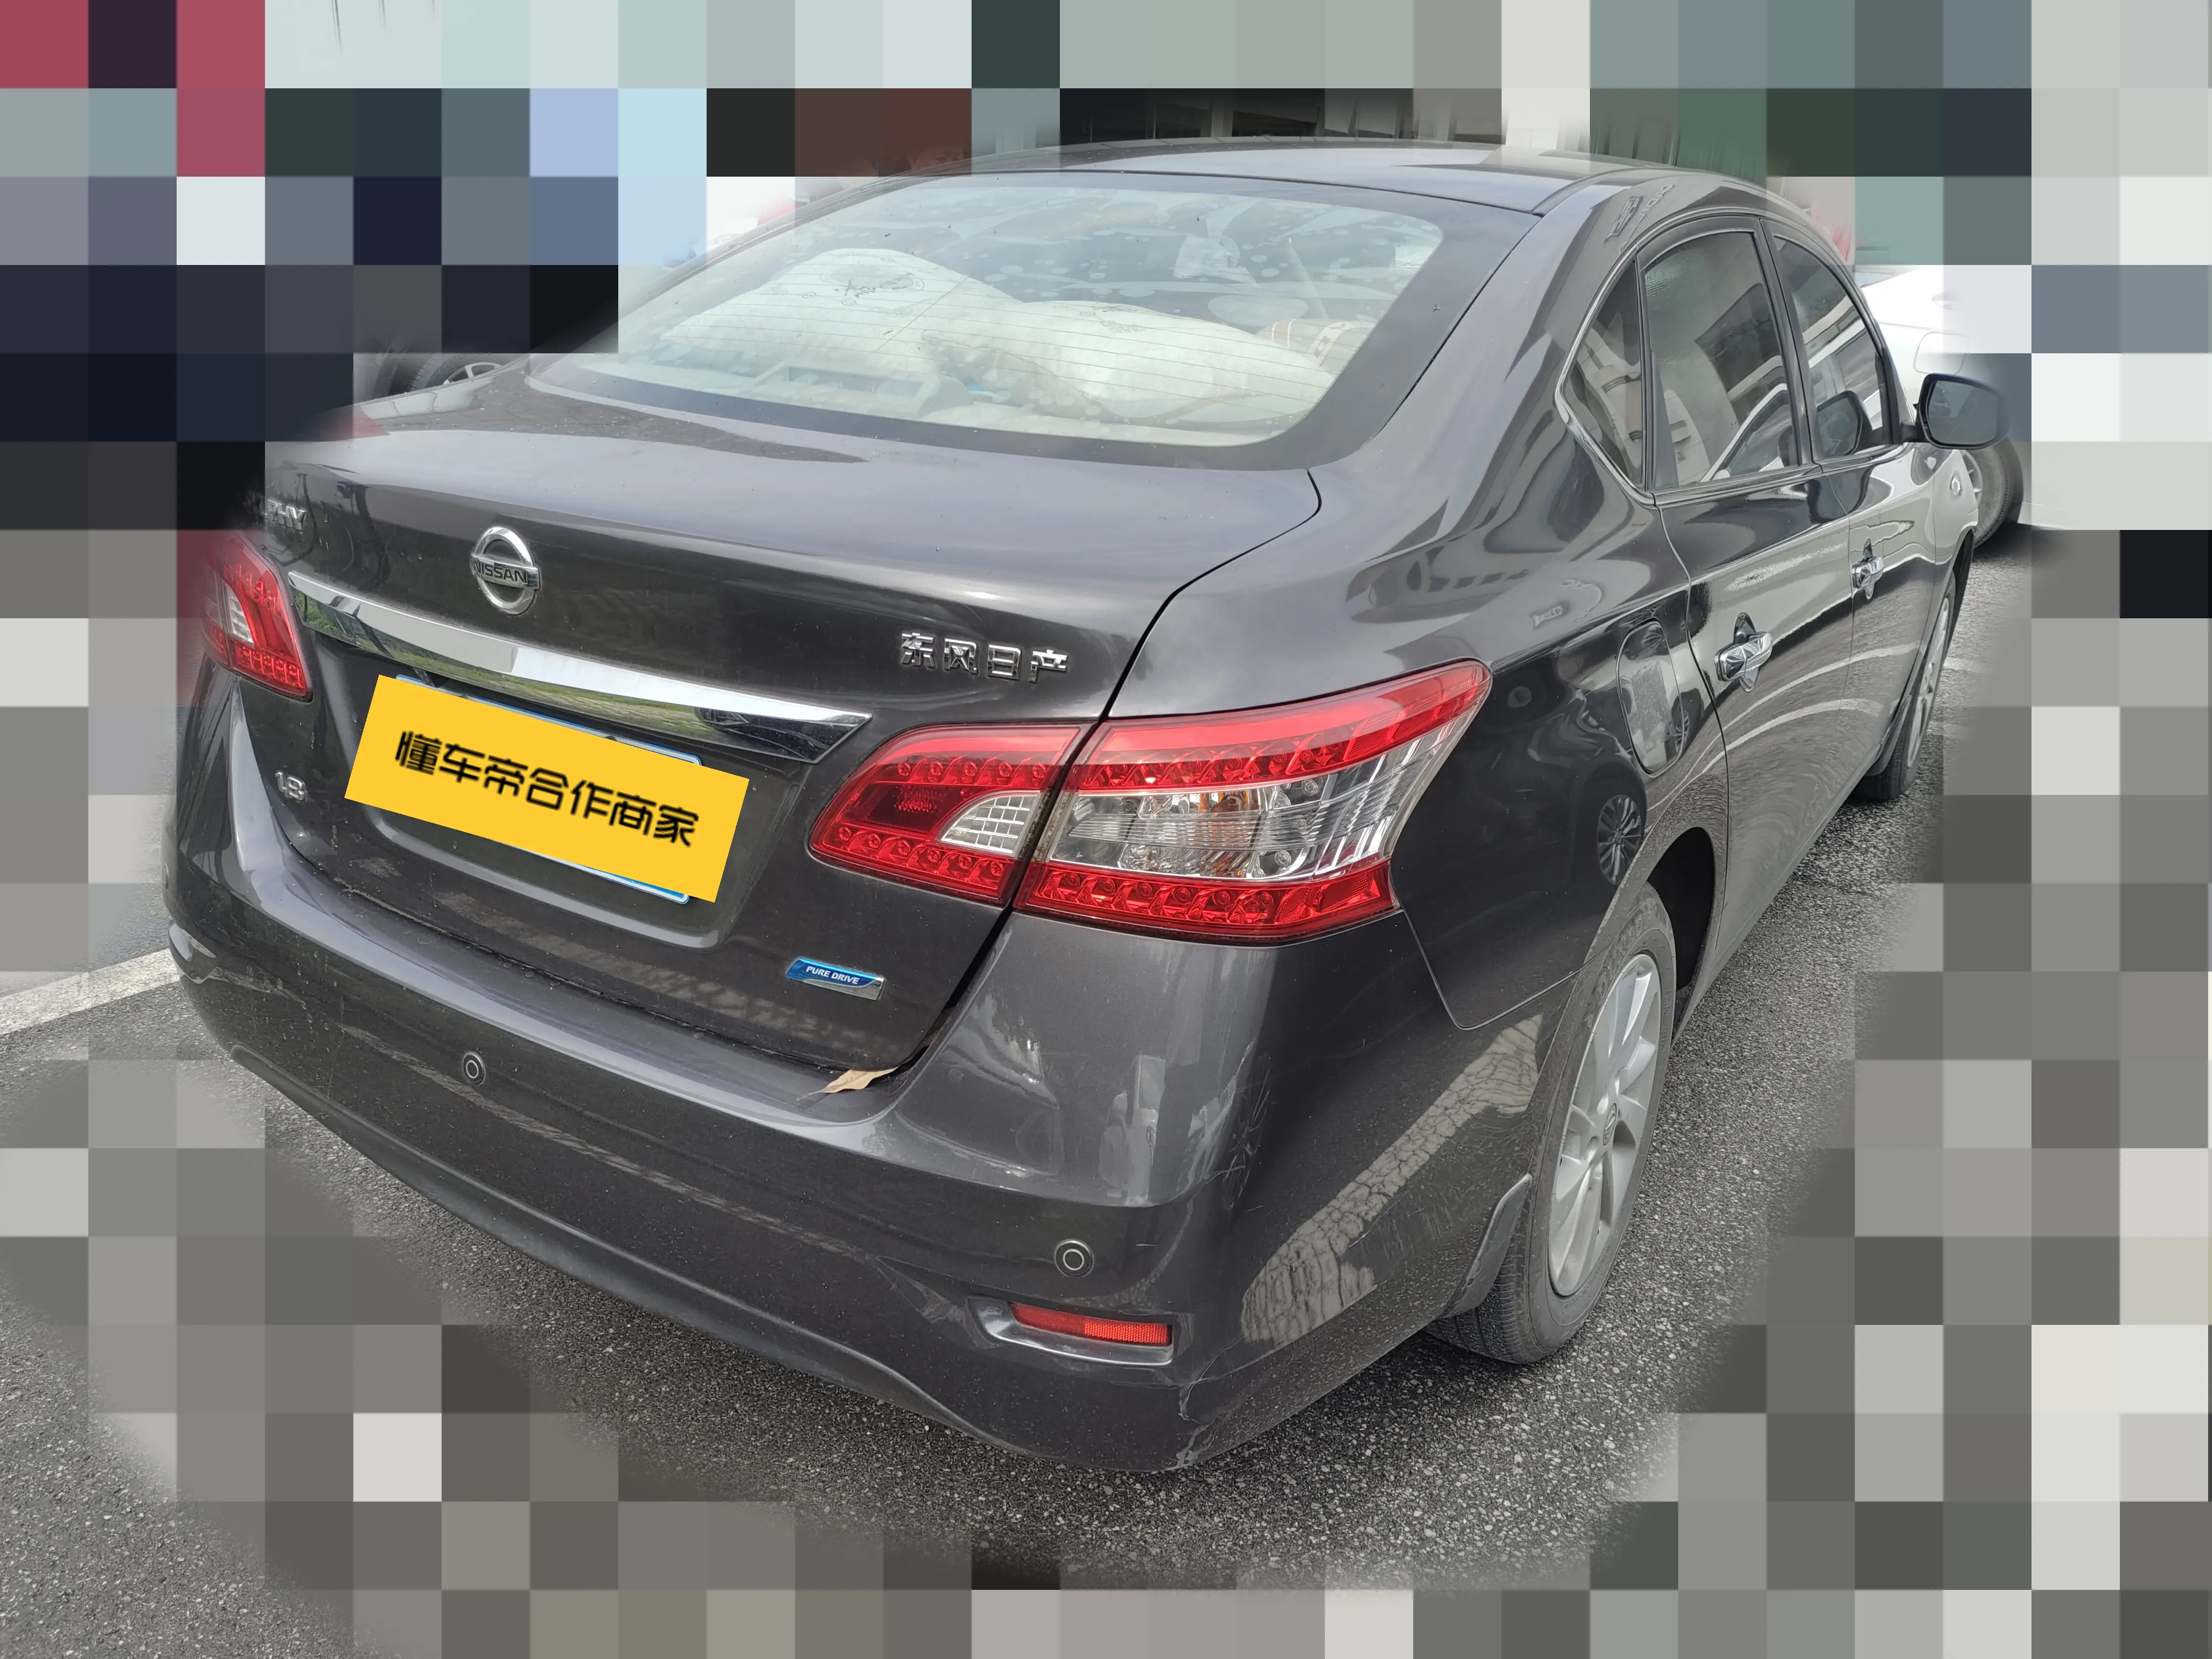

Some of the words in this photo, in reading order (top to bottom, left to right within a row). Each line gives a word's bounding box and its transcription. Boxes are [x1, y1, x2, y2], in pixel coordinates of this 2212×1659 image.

[474, 561, 528, 584] NISSAN
[901, 632, 1069, 683] 东风日产
[806, 966, 831, 977] PURE
[831, 972, 860, 984] DRIVE
